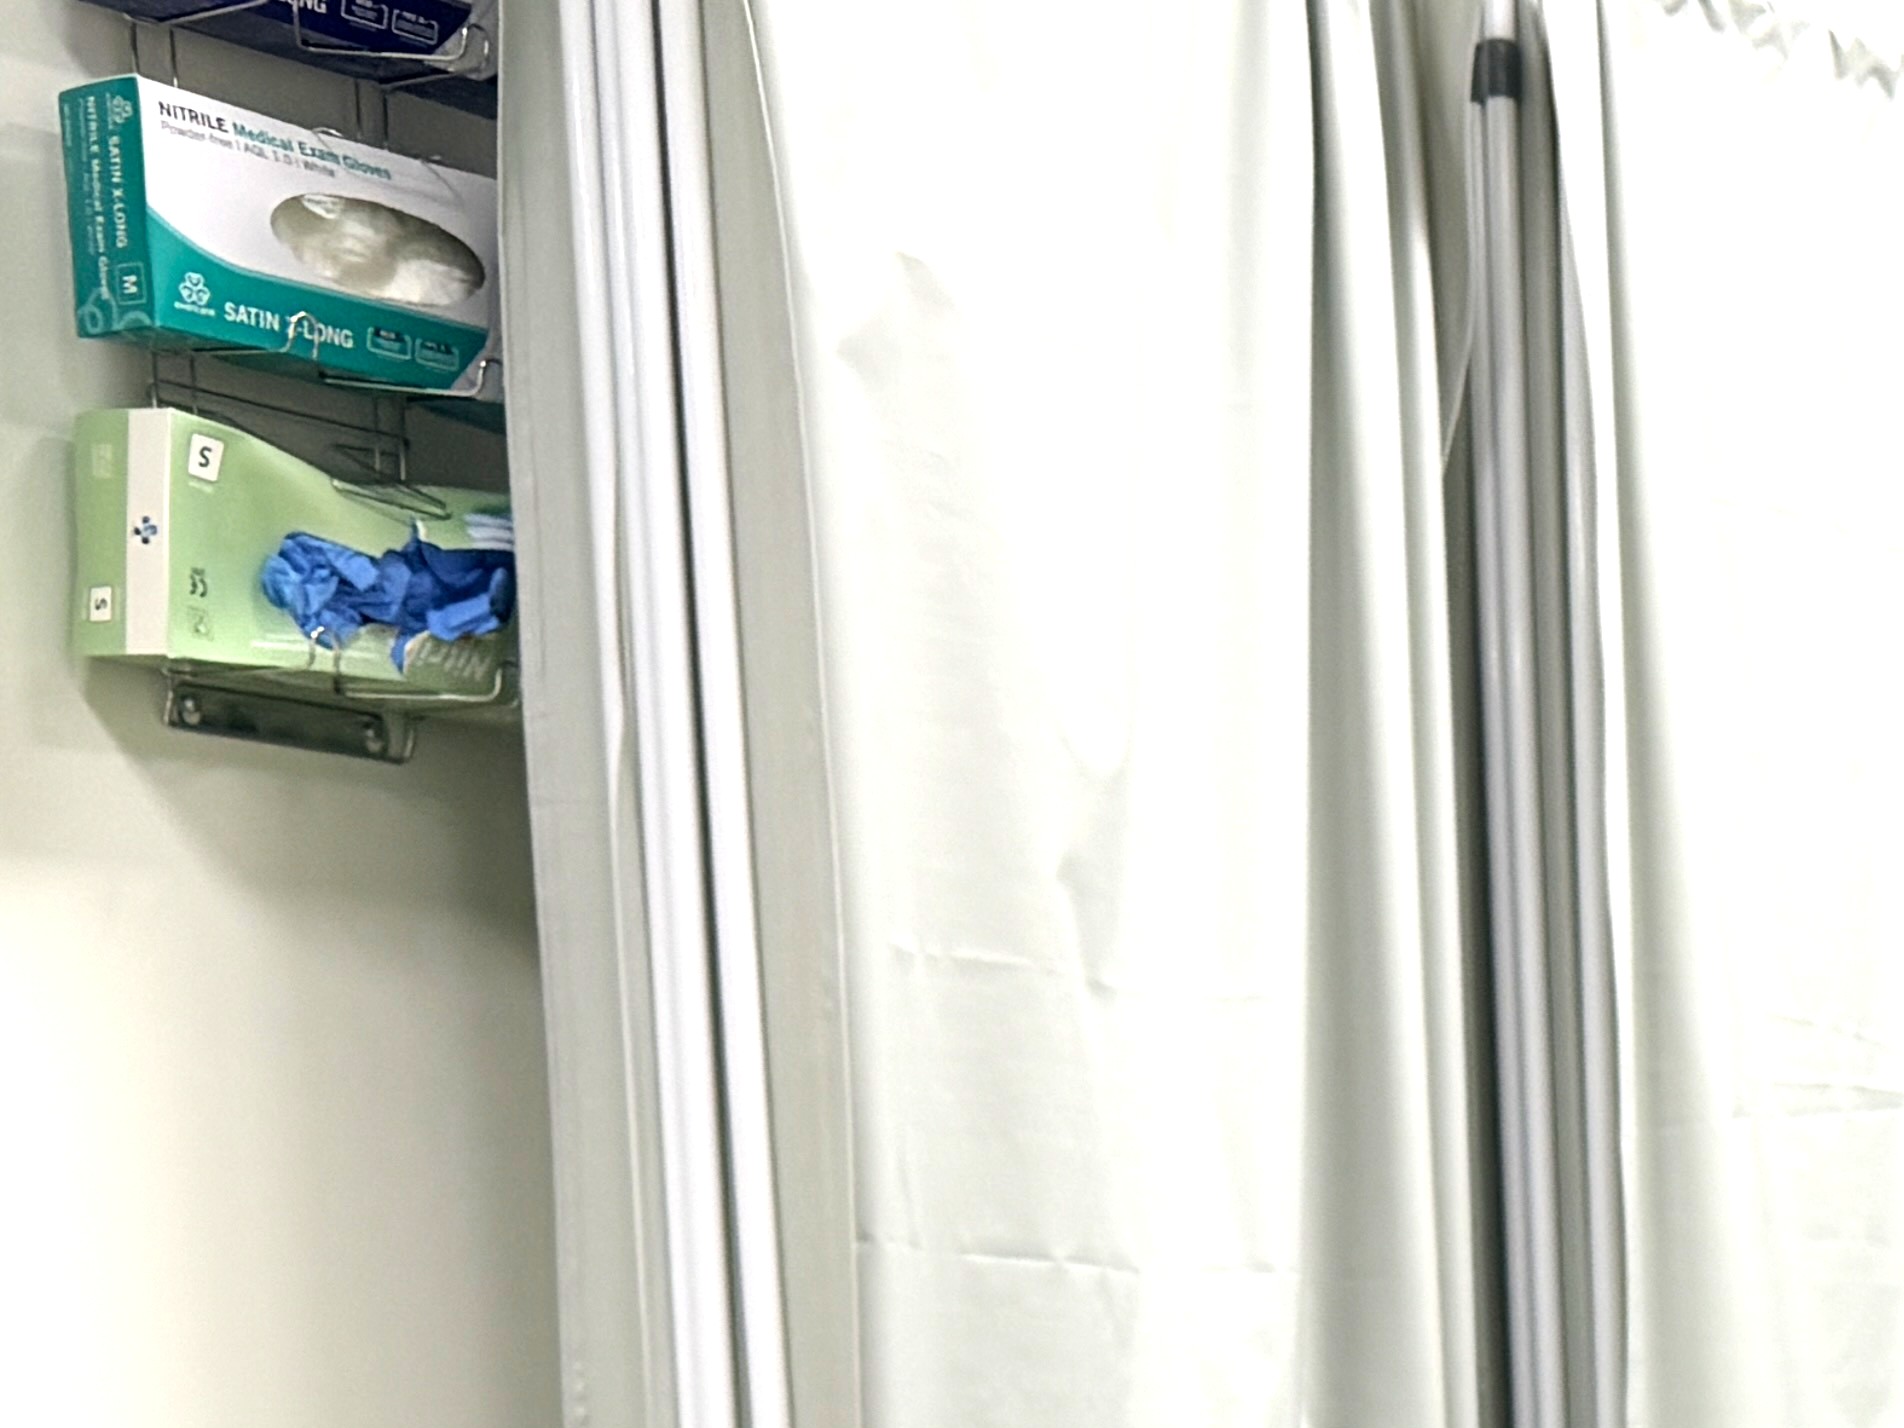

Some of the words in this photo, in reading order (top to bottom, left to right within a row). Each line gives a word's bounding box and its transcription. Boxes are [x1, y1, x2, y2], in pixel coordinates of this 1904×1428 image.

[158, 101, 229, 133] NITRILE
[232, 121, 293, 153] Medical
[298, 141, 341, 166] Exam
[342, 155, 392, 180] Gloves
[108, 135, 123, 183] SATIN
[121, 275, 138, 294] M
[223, 302, 280, 332] SATIN
[198, 446, 213, 468] S
